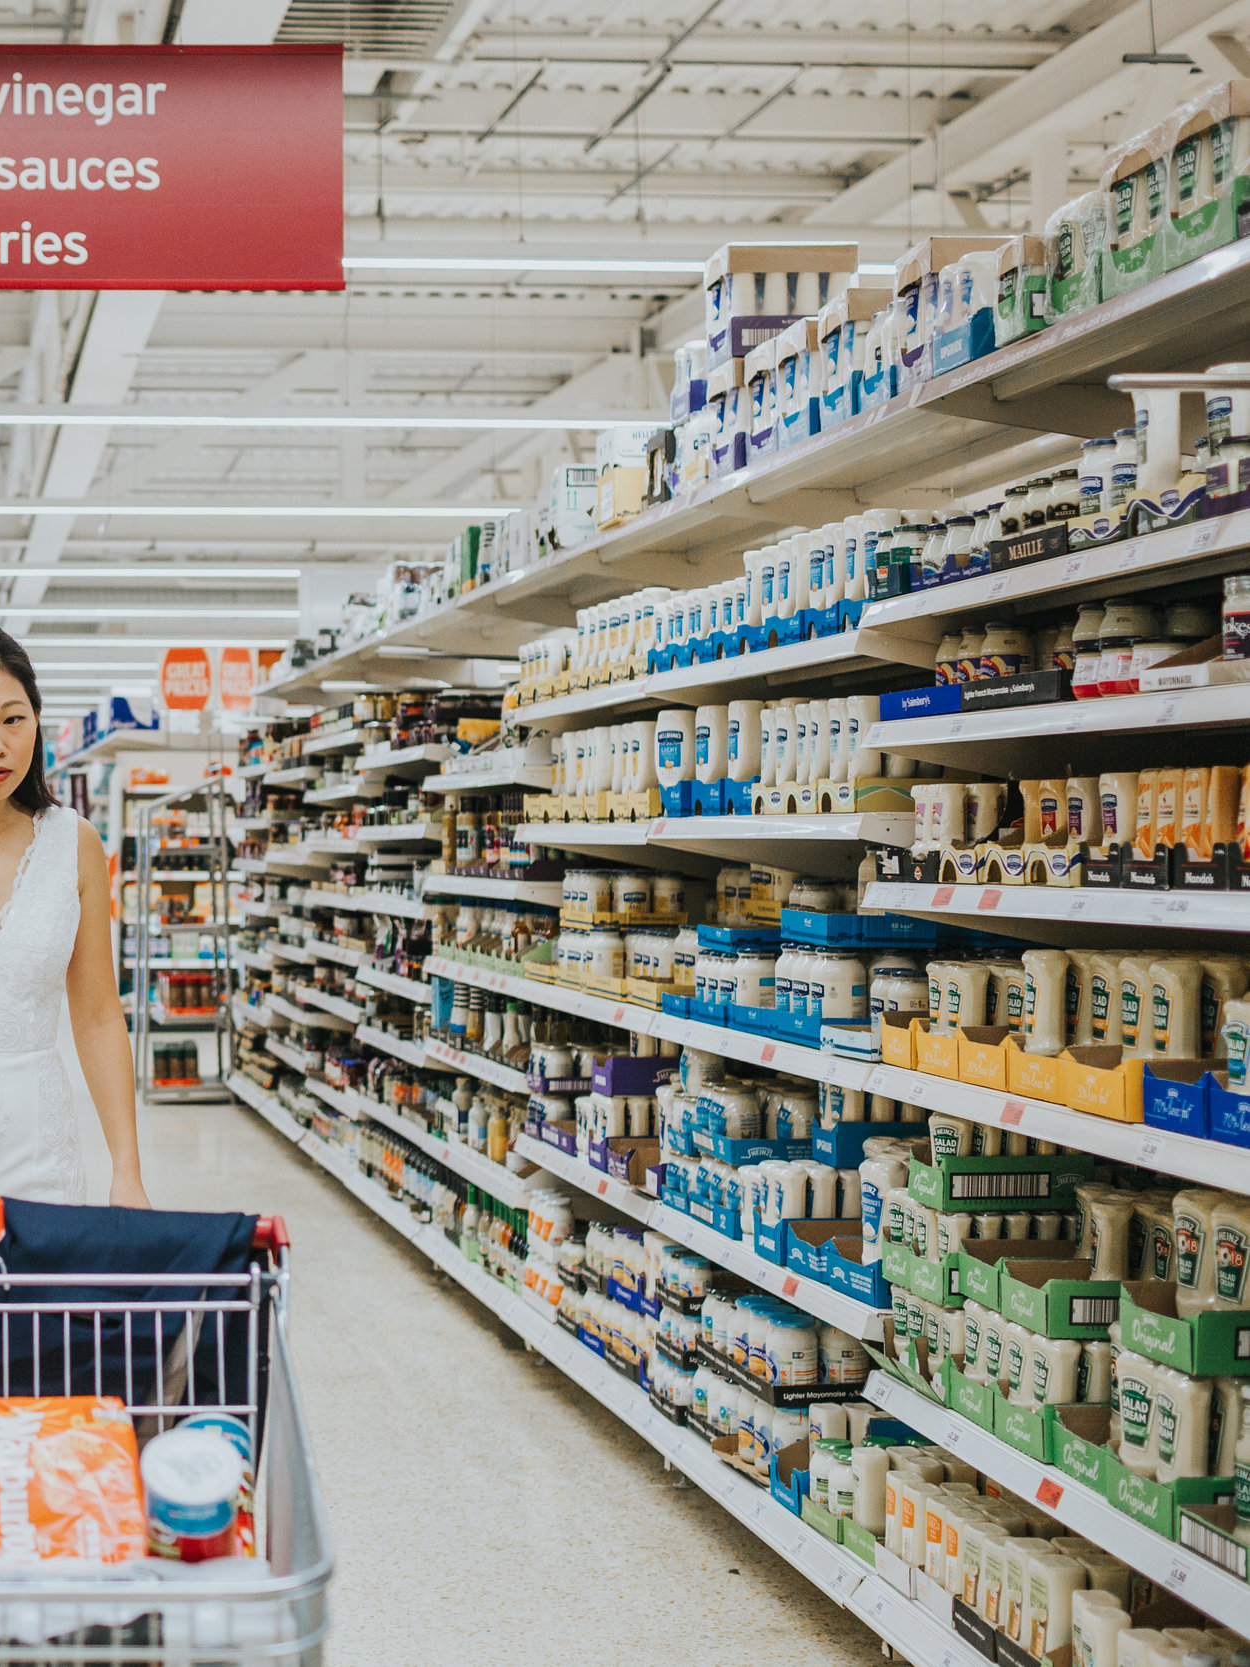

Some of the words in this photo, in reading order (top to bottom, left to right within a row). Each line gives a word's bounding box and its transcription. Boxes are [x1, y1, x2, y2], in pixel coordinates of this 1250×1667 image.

[1007, 538, 1044, 561] MAILLE
[1158, 674, 1193, 686] MAYONNAISE
[1012, 683, 1035, 693] Sainsbury's
[907, 695, 930, 707] Sainsbury's
[658, 732, 683, 742] HELLMANN'S
[1088, 871, 1110, 882] Nando's
[1130, 872, 1155, 884] Nando's
[1185, 872, 1214, 884] Nando's
[935, 1138, 956, 1147] SALAD
[750, 1148, 771, 1157] HEINZ
[913, 1172, 937, 1197] Original
[1059, 1175, 1082, 1185] HEINZ
[1219, 1231, 1239, 1246] HEINZ
[1220, 1271, 1236, 1282] SALAD
[1220, 1278, 1235, 1288] CREAM
[1132, 1319, 1176, 1354] Original
[1124, 1381, 1145, 1394] HEINZ
[783, 1392, 806, 1400] Lighter
[807, 1391, 846, 1399] Mayonnaise
[1063, 1443, 1099, 1481] Original
[1118, 1479, 1157, 1519] Original
